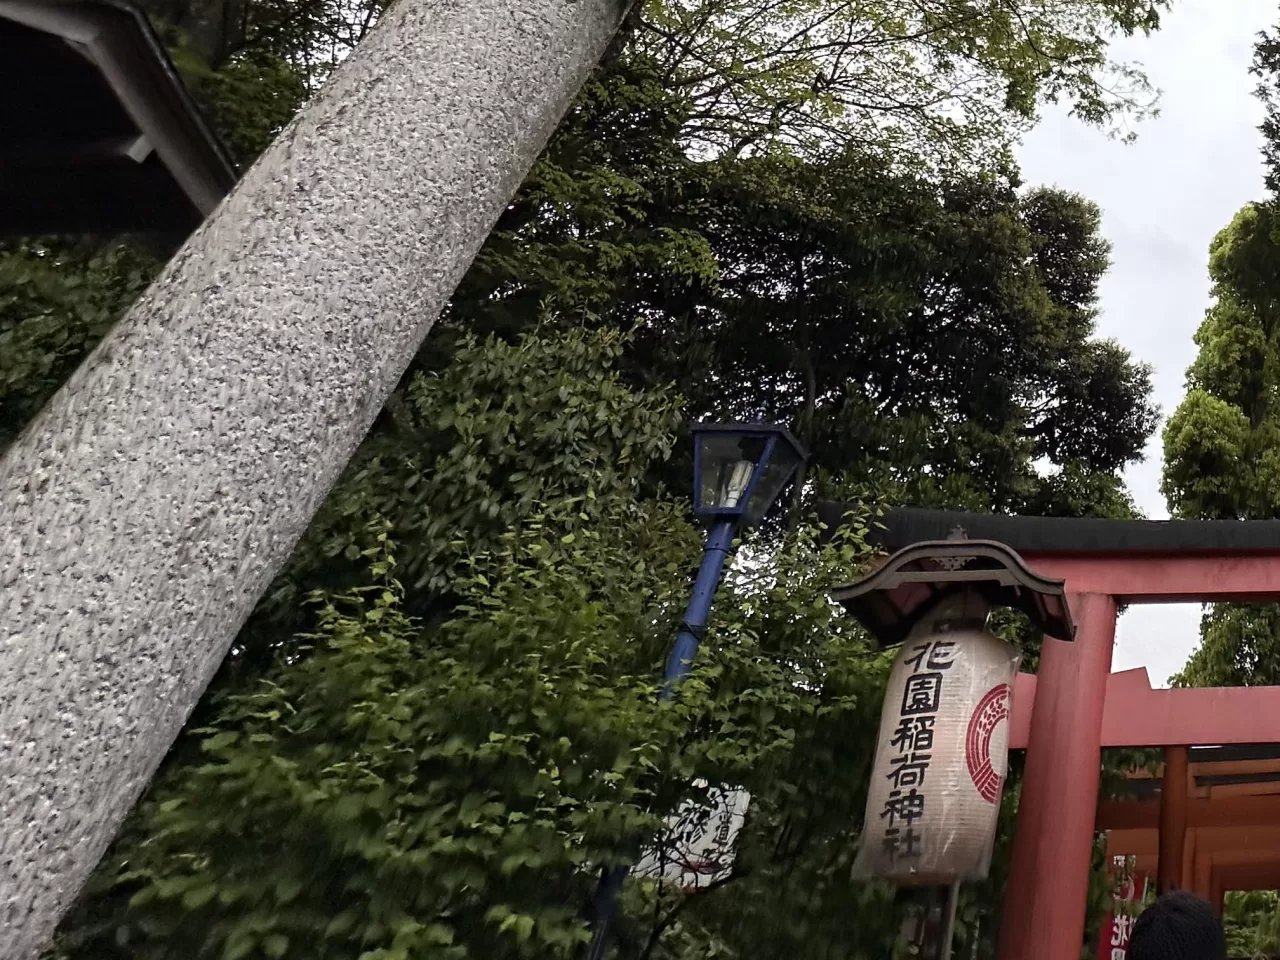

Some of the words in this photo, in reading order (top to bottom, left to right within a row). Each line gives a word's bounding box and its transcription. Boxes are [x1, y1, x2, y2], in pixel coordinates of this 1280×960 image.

[878, 640, 957, 858] 花園稲荷神社
